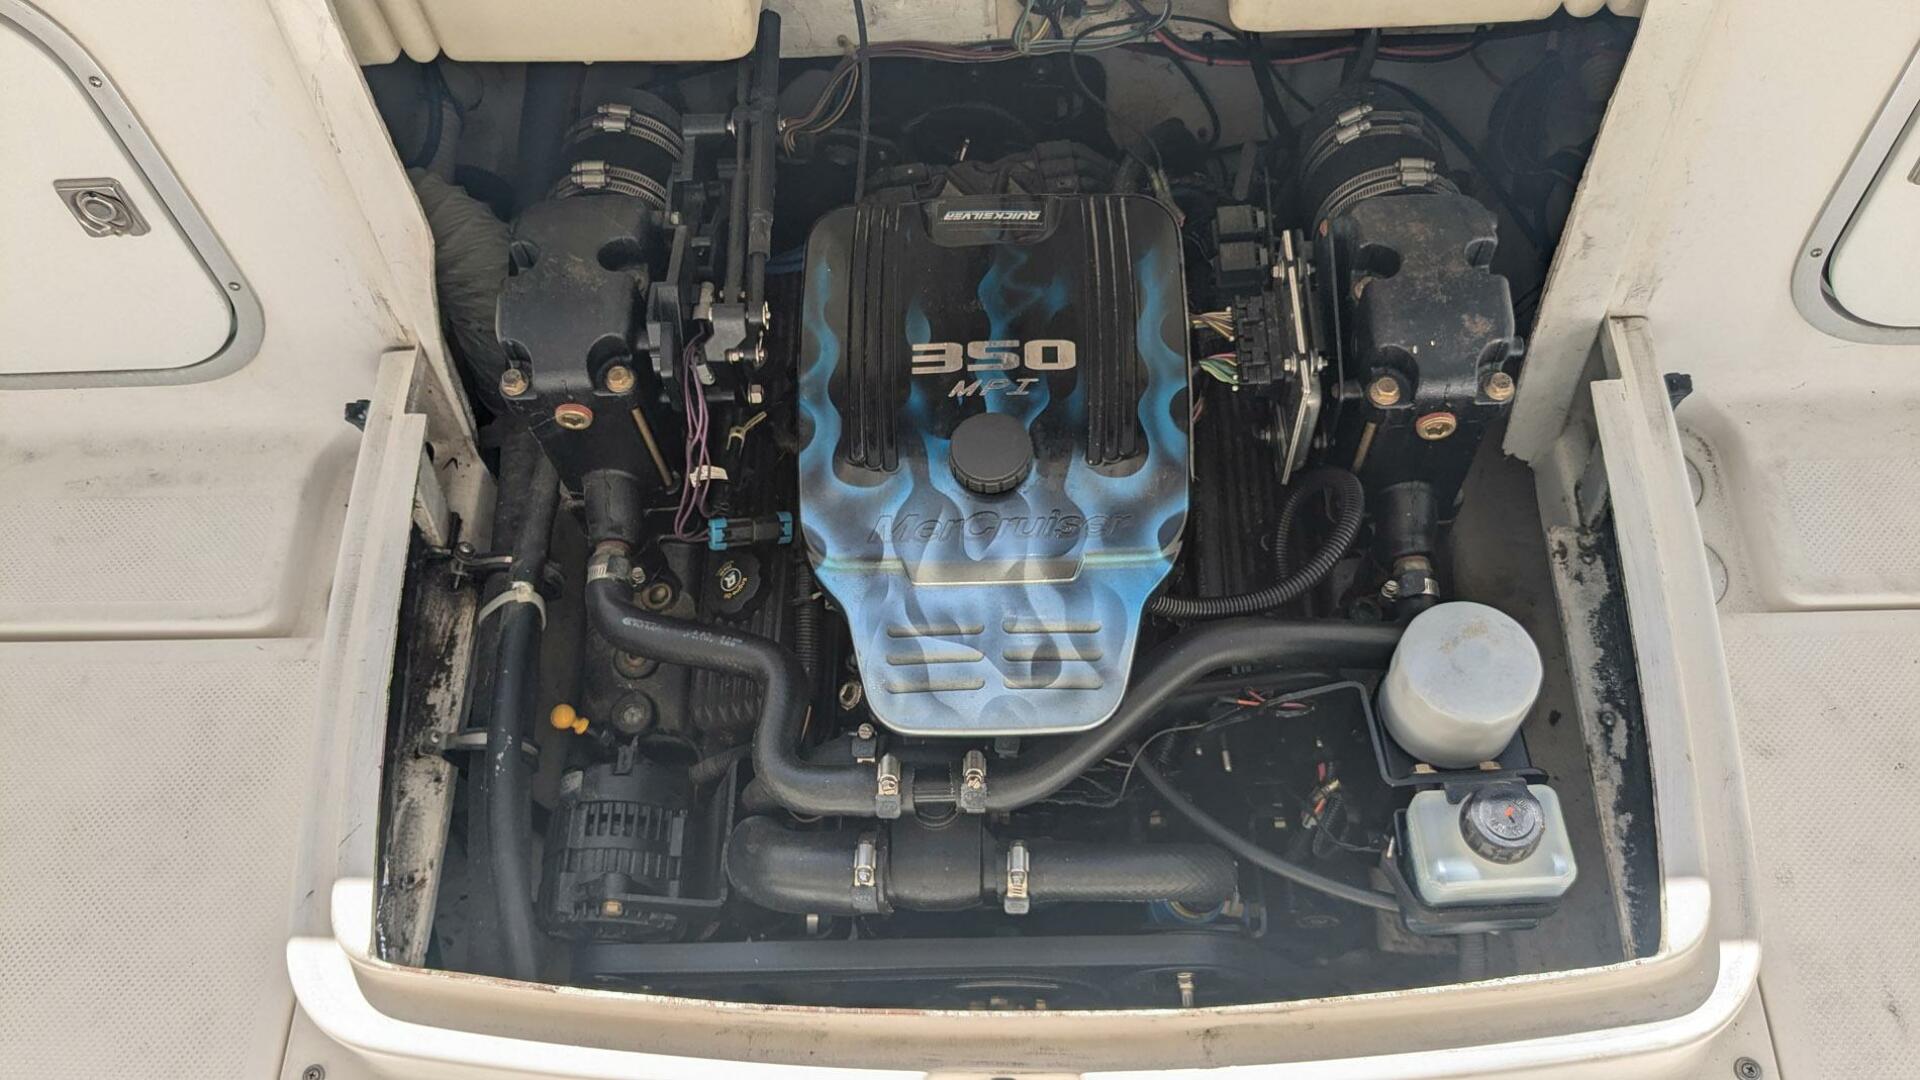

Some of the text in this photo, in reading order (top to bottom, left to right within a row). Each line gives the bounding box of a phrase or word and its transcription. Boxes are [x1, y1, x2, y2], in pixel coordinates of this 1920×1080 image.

[943, 210, 1041, 220] QUICKSILVER
[911, 339, 1077, 375] 350
[948, 377, 1040, 398] MPI
[867, 509, 1132, 544] MerCruiser
